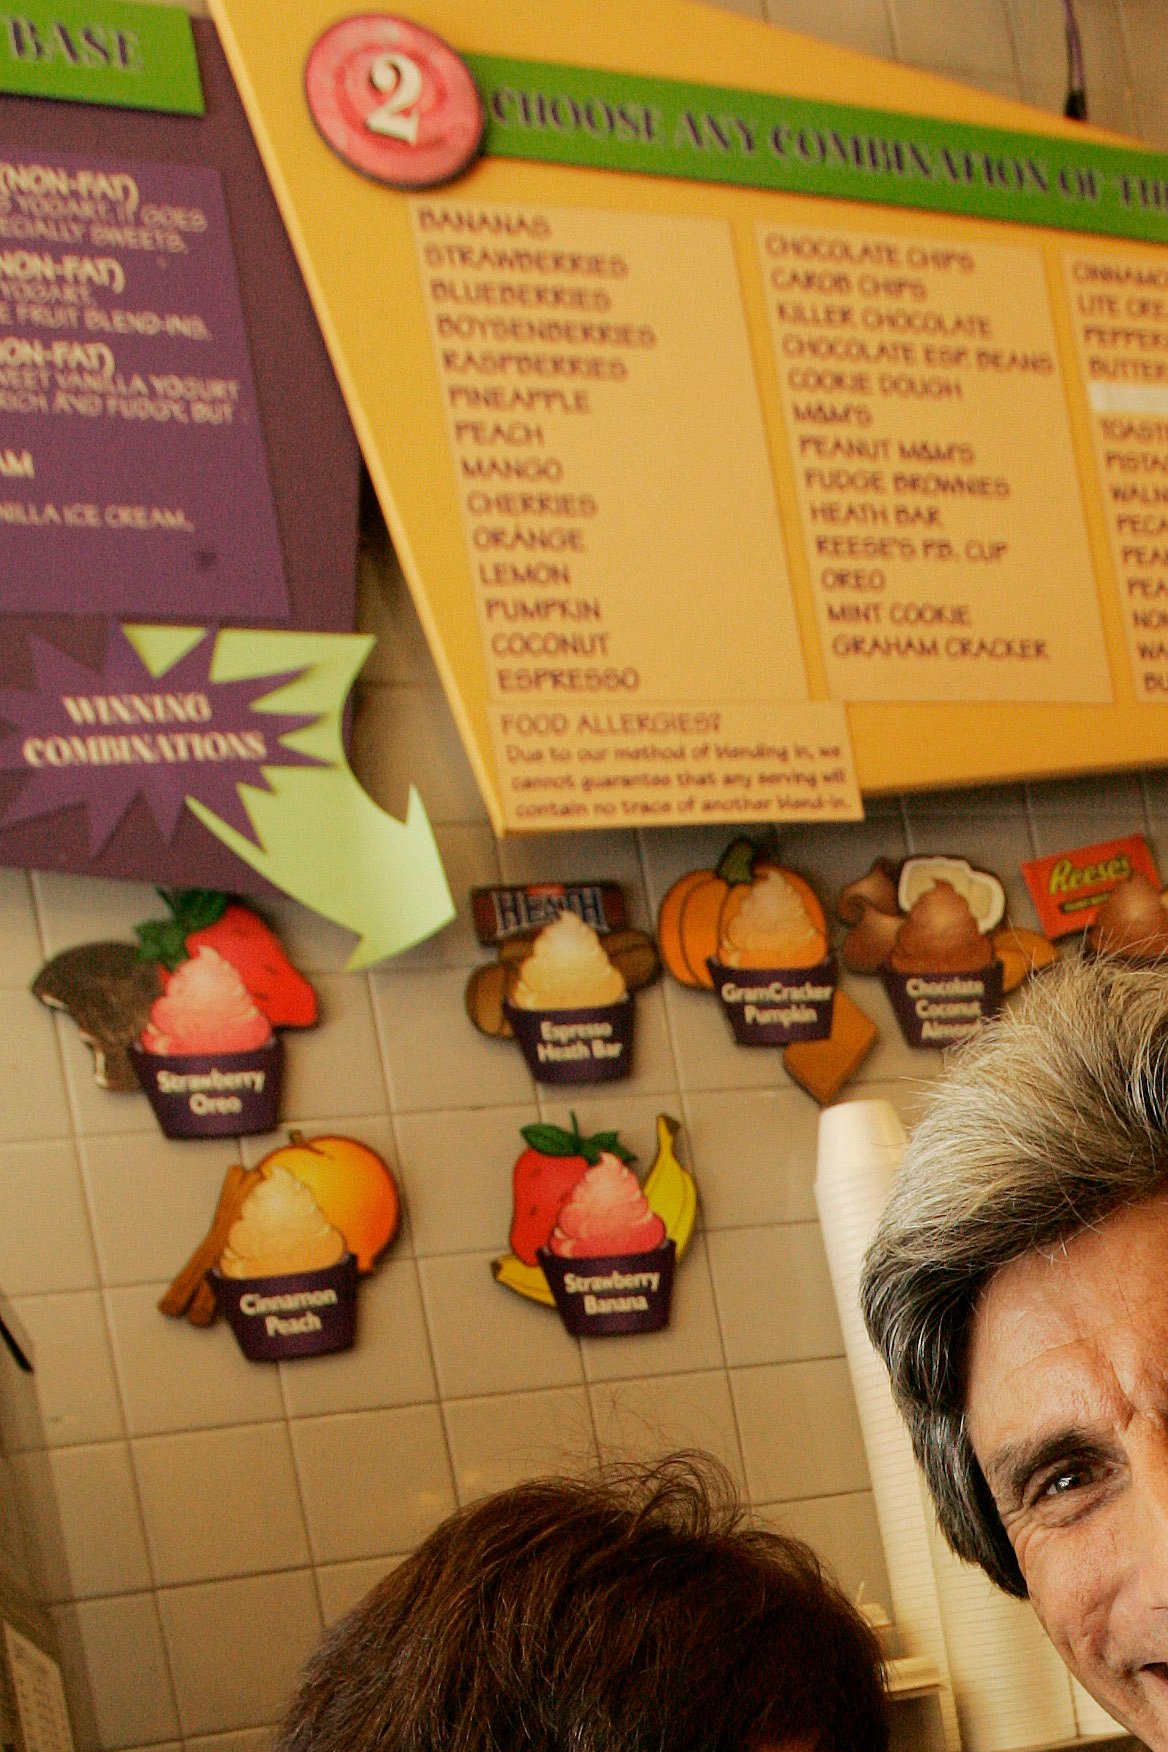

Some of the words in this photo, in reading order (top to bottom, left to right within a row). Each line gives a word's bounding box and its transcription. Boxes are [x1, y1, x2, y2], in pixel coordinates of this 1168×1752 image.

[8, 16, 144, 72] BASE
[365, 54, 422, 145] 2
[490, 88, 666, 146] CHOOSE
[676, 110, 757, 156] ANY
[769, 124, 1050, 196] COMBINATION
[1057, 166, 1098, 202] OF
[418, 208, 551, 238] BANANAS
[424, 244, 629, 278] STRAWBERRIES
[766, 232, 898, 266] CHOCOLATE
[907, 248, 975, 273] CHIPS
[430, 279, 612, 312] BLUEBERRIES
[771, 268, 852, 296] CAROB
[858, 275, 926, 302] CHIPS
[1077, 294, 1121, 318] LITE
[438, 313, 656, 349] BOYSENBERRIES
[777, 302, 853, 329] KILLER
[861, 307, 993, 338] CHOCOLATE
[442, 348, 629, 381] RASPBERRIES
[782, 334, 917, 369] CHOCOLATE
[976, 348, 1055, 377] BEANS
[788, 368, 874, 396] COOKIE
[879, 375, 964, 400] DOUGH
[447, 384, 592, 414] PINEAPPLE
[455, 421, 544, 447] PEACH
[798, 436, 892, 462] PEANUT
[462, 457, 563, 482] MANGO
[805, 469, 887, 495] FUDGE
[893, 473, 1011, 499] BROWNIES
[468, 491, 598, 518] CHERRIES
[809, 501, 889, 528] HEATH
[894, 504, 943, 529] BAR
[473, 527, 585, 552] ORANGE
[964, 540, 1010, 565] CUP
[480, 562, 571, 586] LEMON
[820, 568, 886, 592] OREO
[486, 598, 602, 622] PUMPKIN
[827, 602, 882, 627] MINT
[889, 602, 972, 629] COOKIE
[491, 633, 610, 658] COCONUT
[832, 634, 940, 661] GRAHAM
[945, 636, 1051, 662] CRACKER
[497, 667, 640, 690] ESPRESSO
[61, 691, 212, 726] WINNING
[502, 713, 567, 735] FOOD
[577, 711, 722, 735] ALLERGIES?
[22, 730, 267, 768] COMBINATIONS
[506, 745, 542, 763] Due
[550, 746, 571, 763] to
[577, 747, 607, 763] our
[615, 745, 686, 762] method
[691, 743, 710, 761] of
[715, 743, 787, 763] blending
[818, 745, 842, 759] we
[511, 774, 576, 792] cannot
[581, 773, 672, 792] guarantee
[677, 772, 717, 788] that
[723, 772, 751, 790] any
[758, 770, 817, 788] serving
[822, 769, 847, 784] will
[516, 800, 588, 818] contain
[593, 801, 616, 818] no
[623, 799, 672, 816] trace
[677, 796, 696, 814] of
[701, 796, 771, 813] another
[744, 1005, 818, 1027] Pumpkin
[156, 1068, 266, 1096] Strawberry
[189, 1093, 242, 1116] Oreo
[563, 1269, 660, 1296] Strawberry
[238, 1287, 339, 1316] Cinnamon
[582, 1293, 650, 1316] Banana
[265, 1313, 324, 1338] Peach
